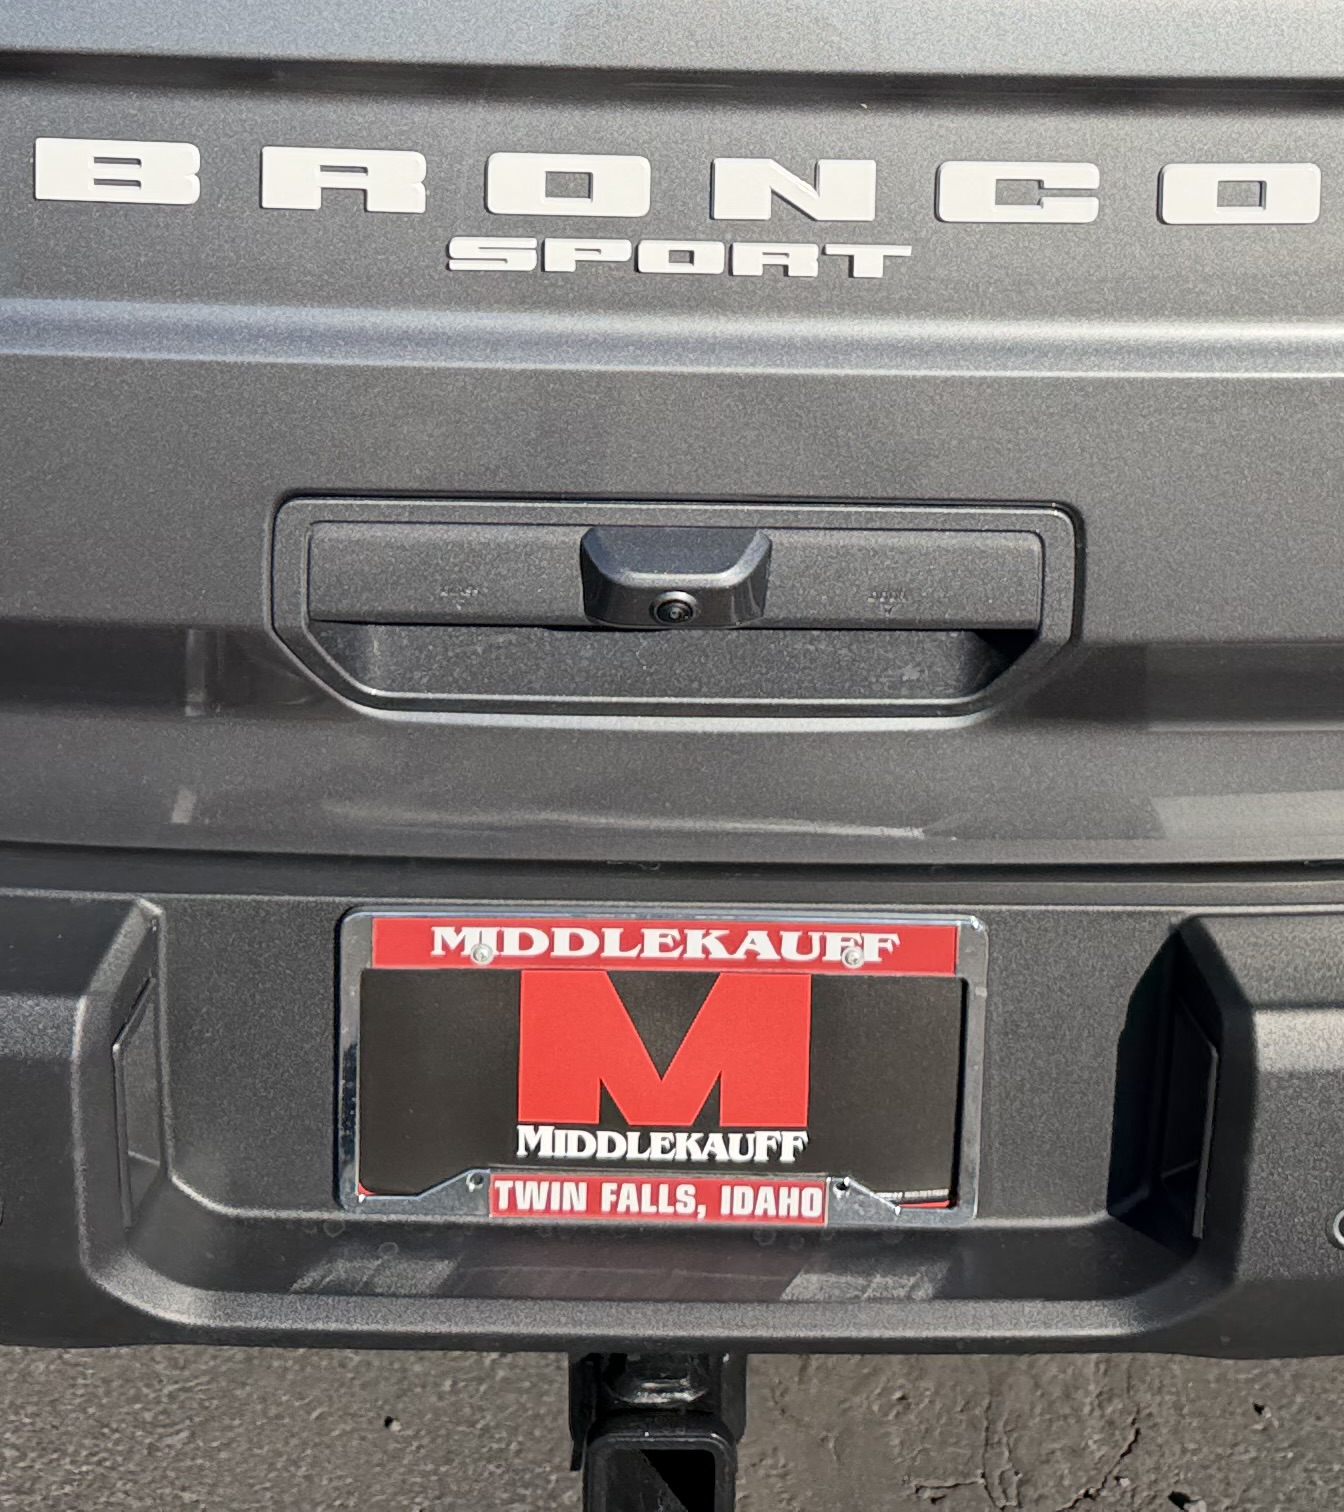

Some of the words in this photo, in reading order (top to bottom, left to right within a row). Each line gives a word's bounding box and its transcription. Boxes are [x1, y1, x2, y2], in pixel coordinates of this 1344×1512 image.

[34, 137, 1323, 225] BRONCO
[447, 236, 913, 279] SPORT
[430, 926, 901, 963] MIDDLEKAUFF
[517, 969, 811, 1127] M
[517, 1124, 809, 1163] MIDDLEKAUFF
[495, 1181, 587, 1213] TWIN
[601, 1182, 706, 1217] FALLS,
[720, 1185, 824, 1217] IDAHO
